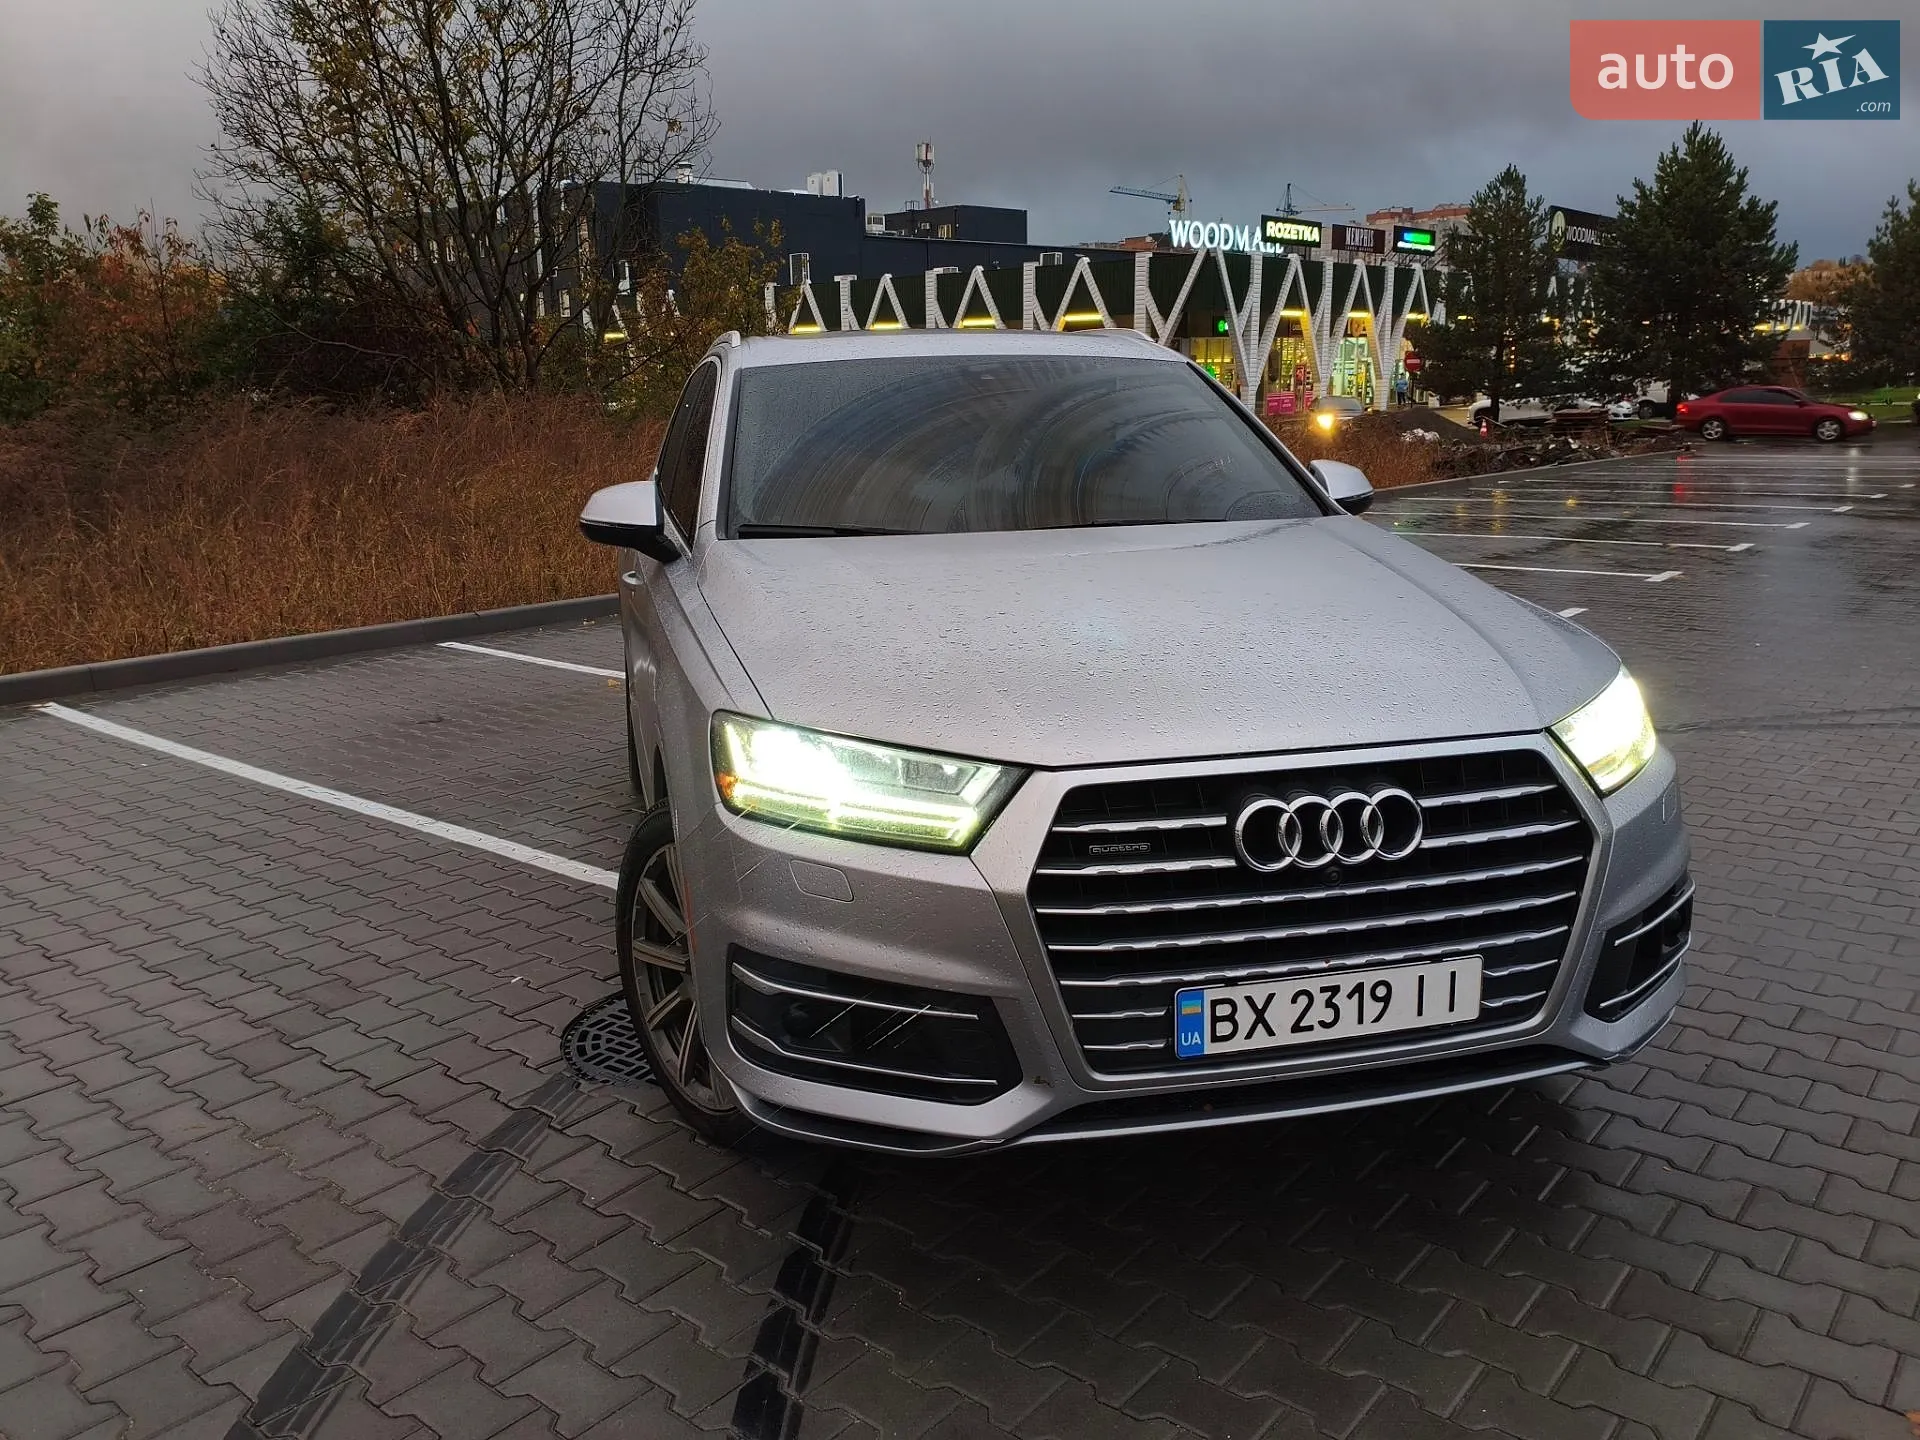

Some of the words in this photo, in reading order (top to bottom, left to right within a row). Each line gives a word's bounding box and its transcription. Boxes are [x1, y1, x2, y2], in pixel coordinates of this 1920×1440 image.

[1266, 221, 1320, 242] ROZETKA
[1092, 844, 1148, 855] quattro
[1209, 992, 1277, 1044] BX
[1290, 979, 1393, 1034] 2319
[1181, 1031, 1201, 1046] UA
